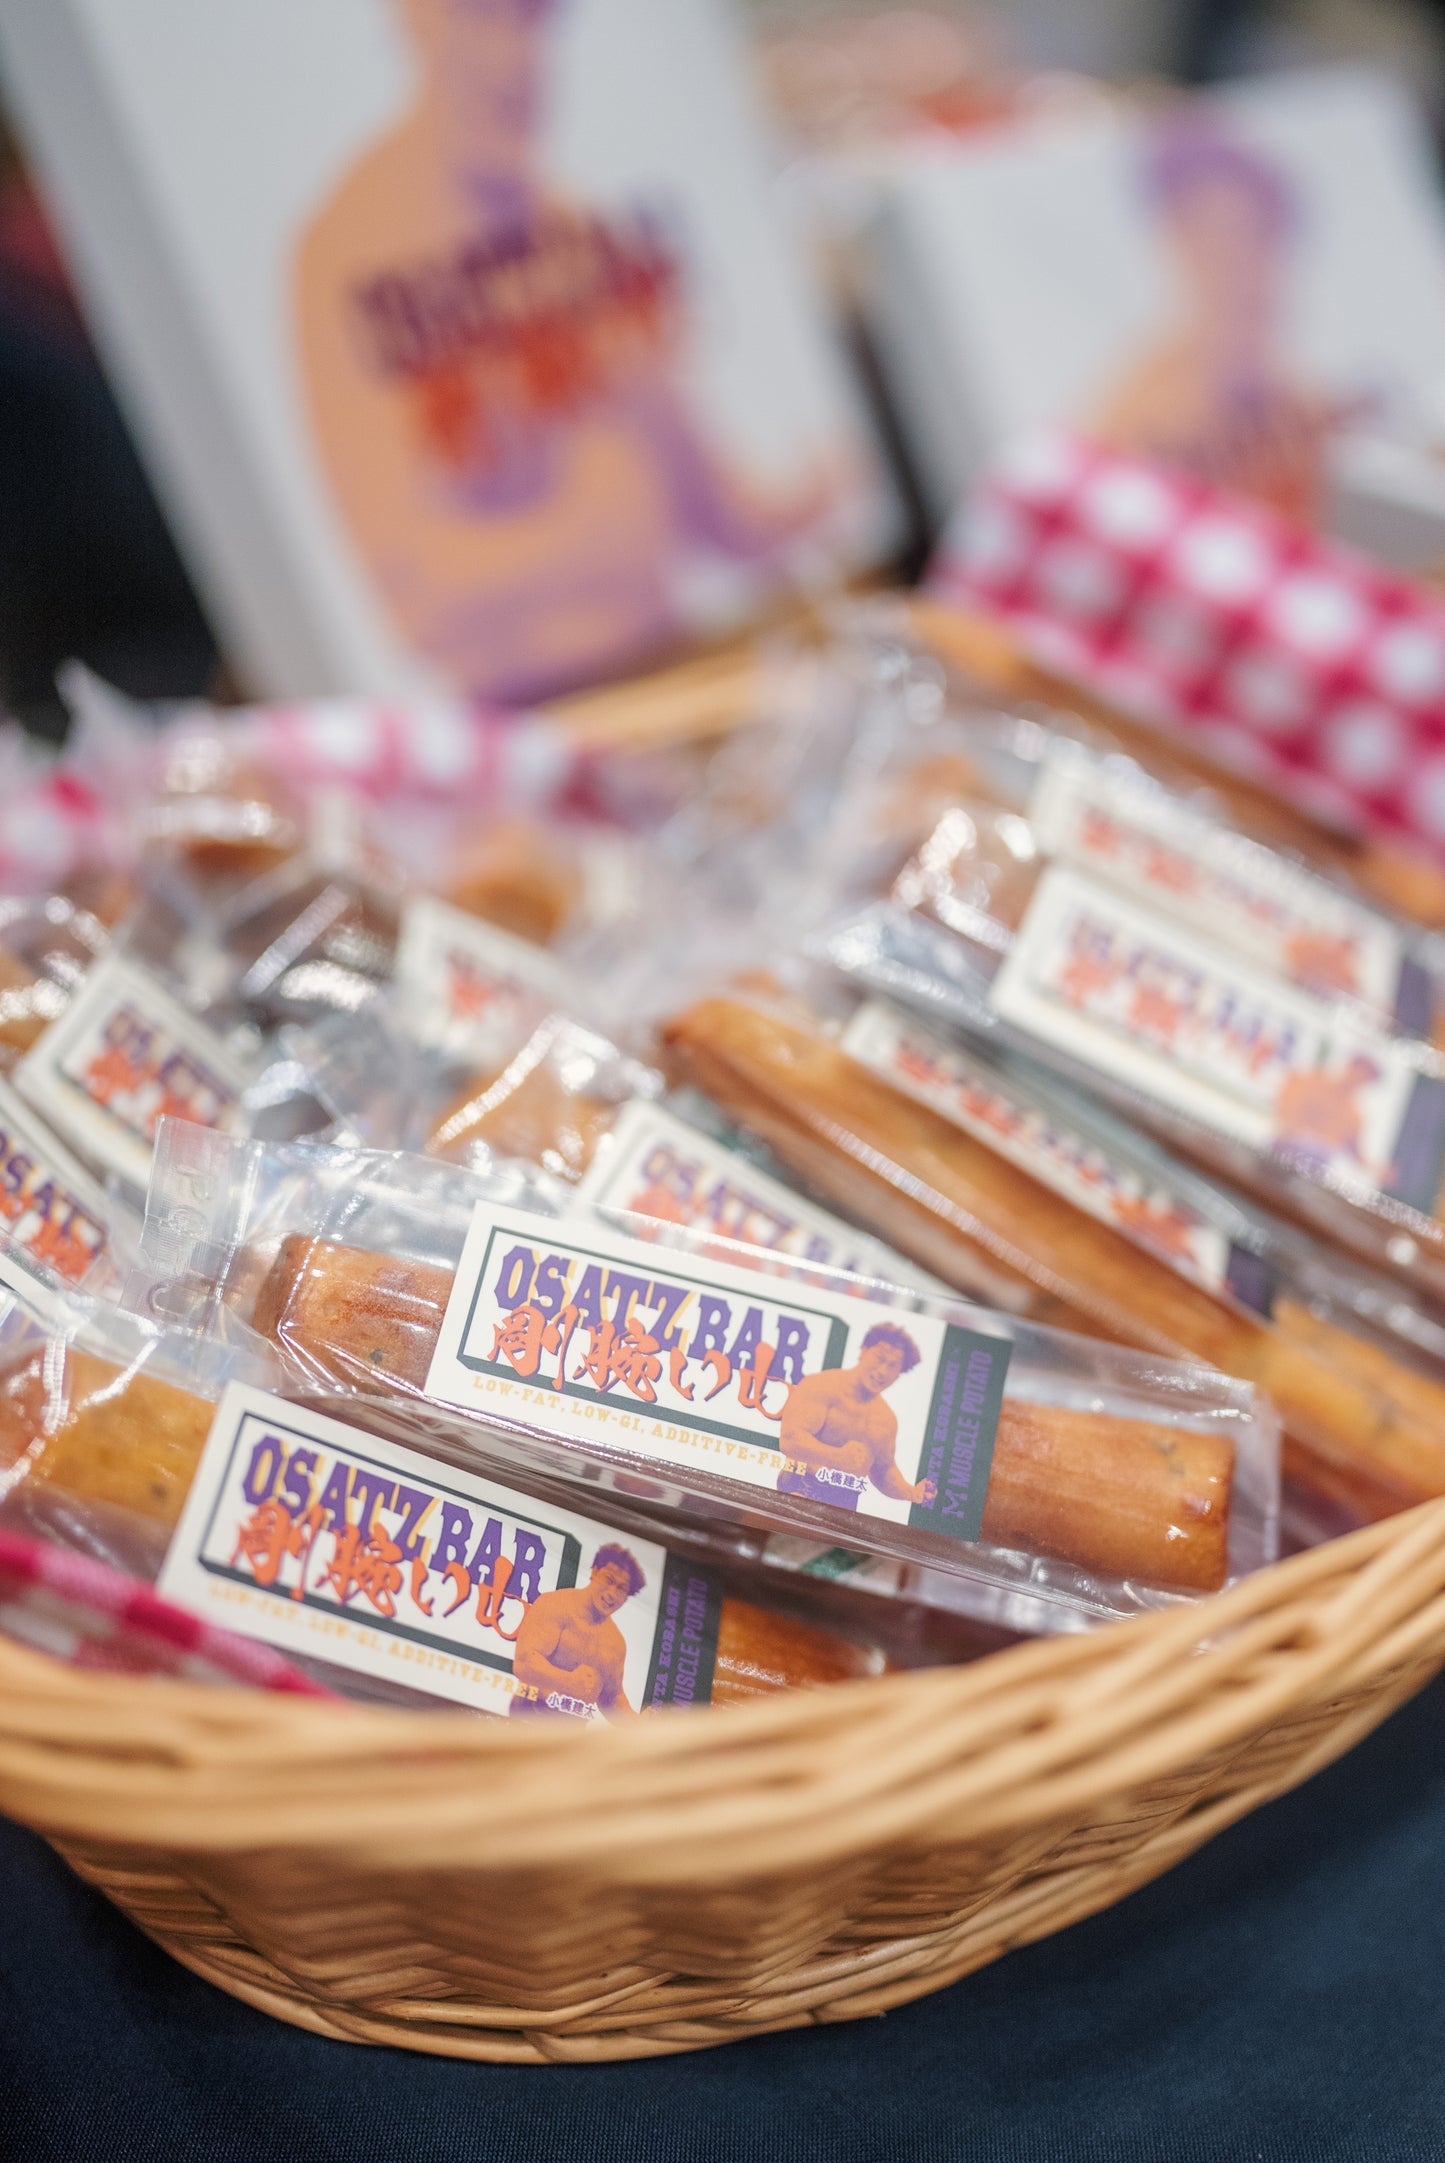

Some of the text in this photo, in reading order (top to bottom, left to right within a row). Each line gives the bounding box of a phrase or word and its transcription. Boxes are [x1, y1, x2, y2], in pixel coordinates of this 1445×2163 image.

[494, 1245, 810, 1386] OSATZ BAR
[960, 1349, 993, 1415] POTATO
[651, 1412, 808, 1476] ADDITIVE-FREE
[948, 1415, 980, 1489] MUSCLE
[816, 1466, 868, 1492] 小橋建太
[242, 1435, 546, 1605] OSATZ BAR
[681, 1577, 708, 1641] POTATO
